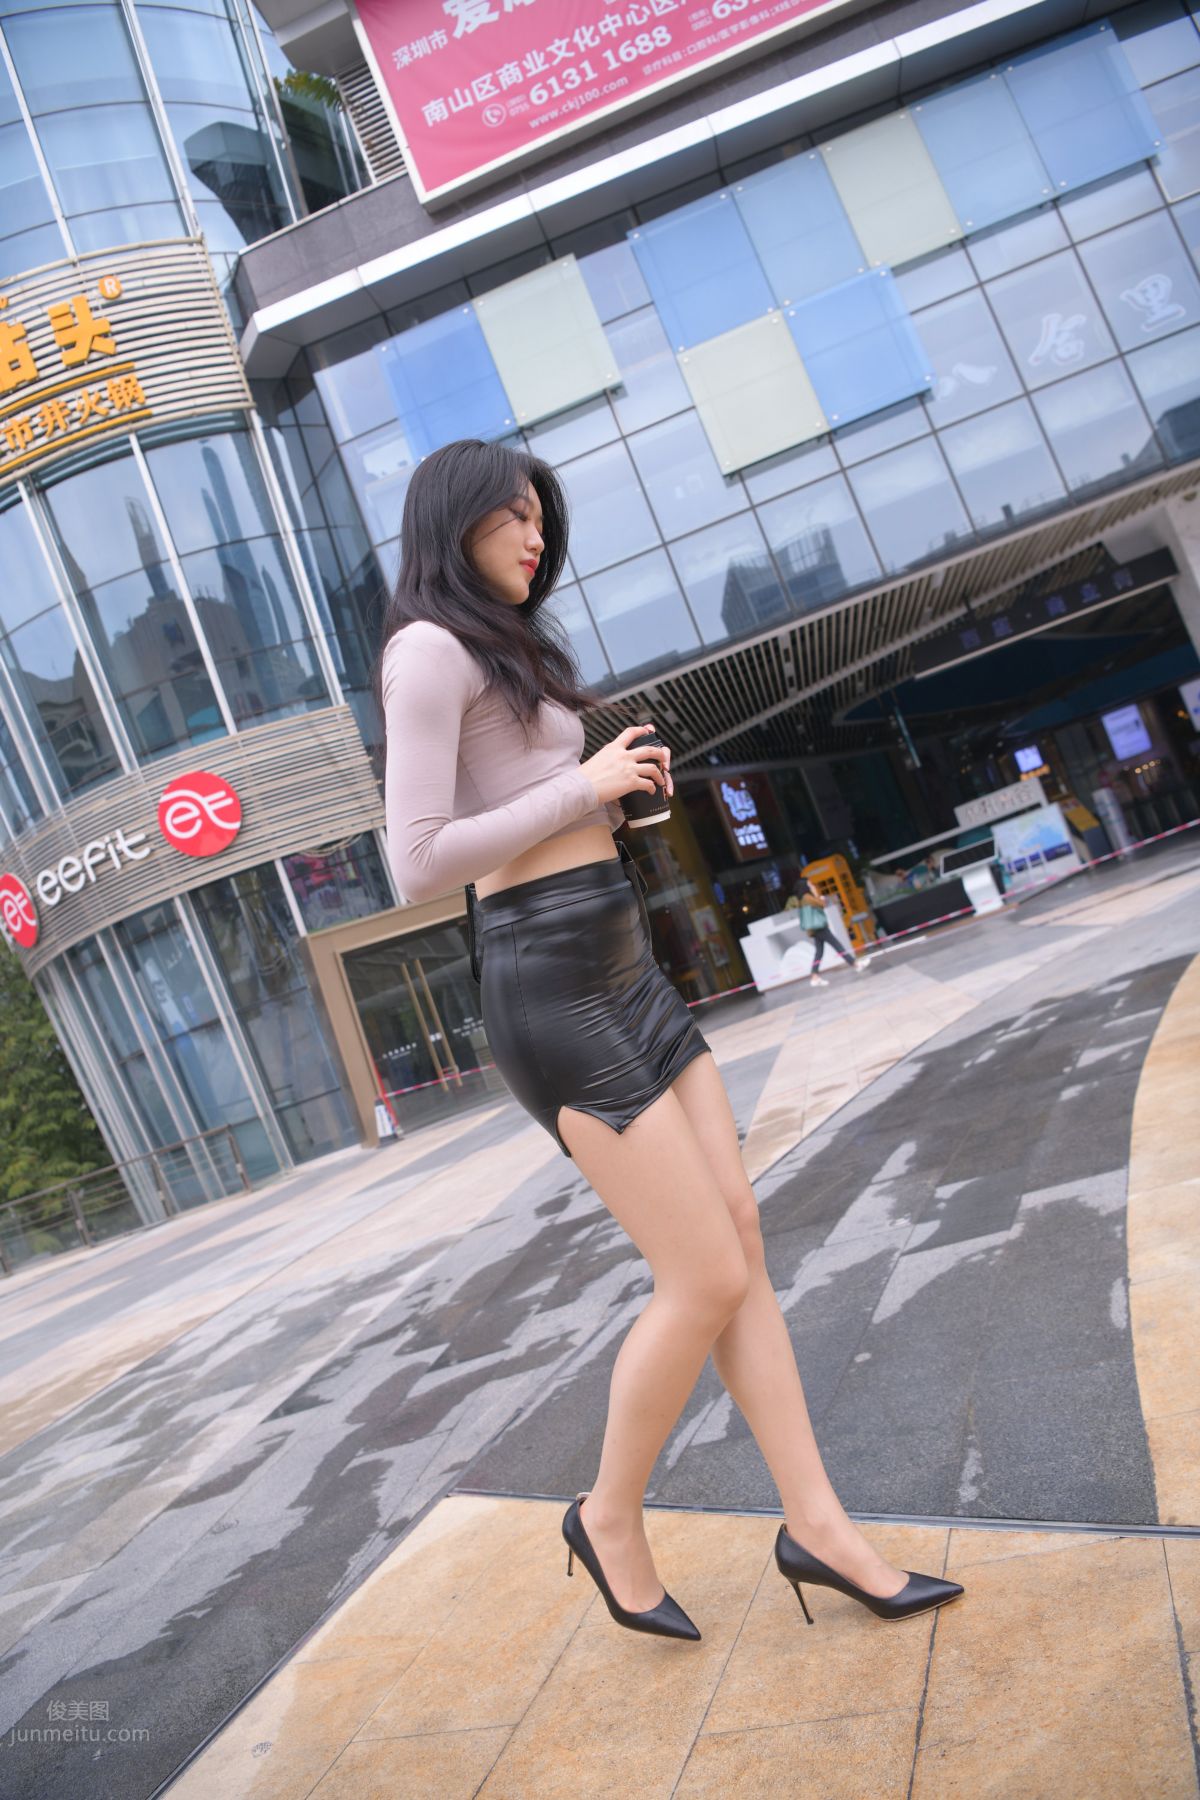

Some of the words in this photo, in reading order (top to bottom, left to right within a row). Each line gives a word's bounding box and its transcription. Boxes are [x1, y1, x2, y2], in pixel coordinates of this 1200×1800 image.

[392, 29, 449, 70] 深圳市
[421, 0, 686, 127] 南山区商业文化中心区
[529, 60, 599, 106] 6131
[602, 25, 673, 71] 1688
[529, 76, 629, 128] www.ckj100.com
[0, 374, 146, 450] 市井火锅
[36, 829, 151, 906] eefit
